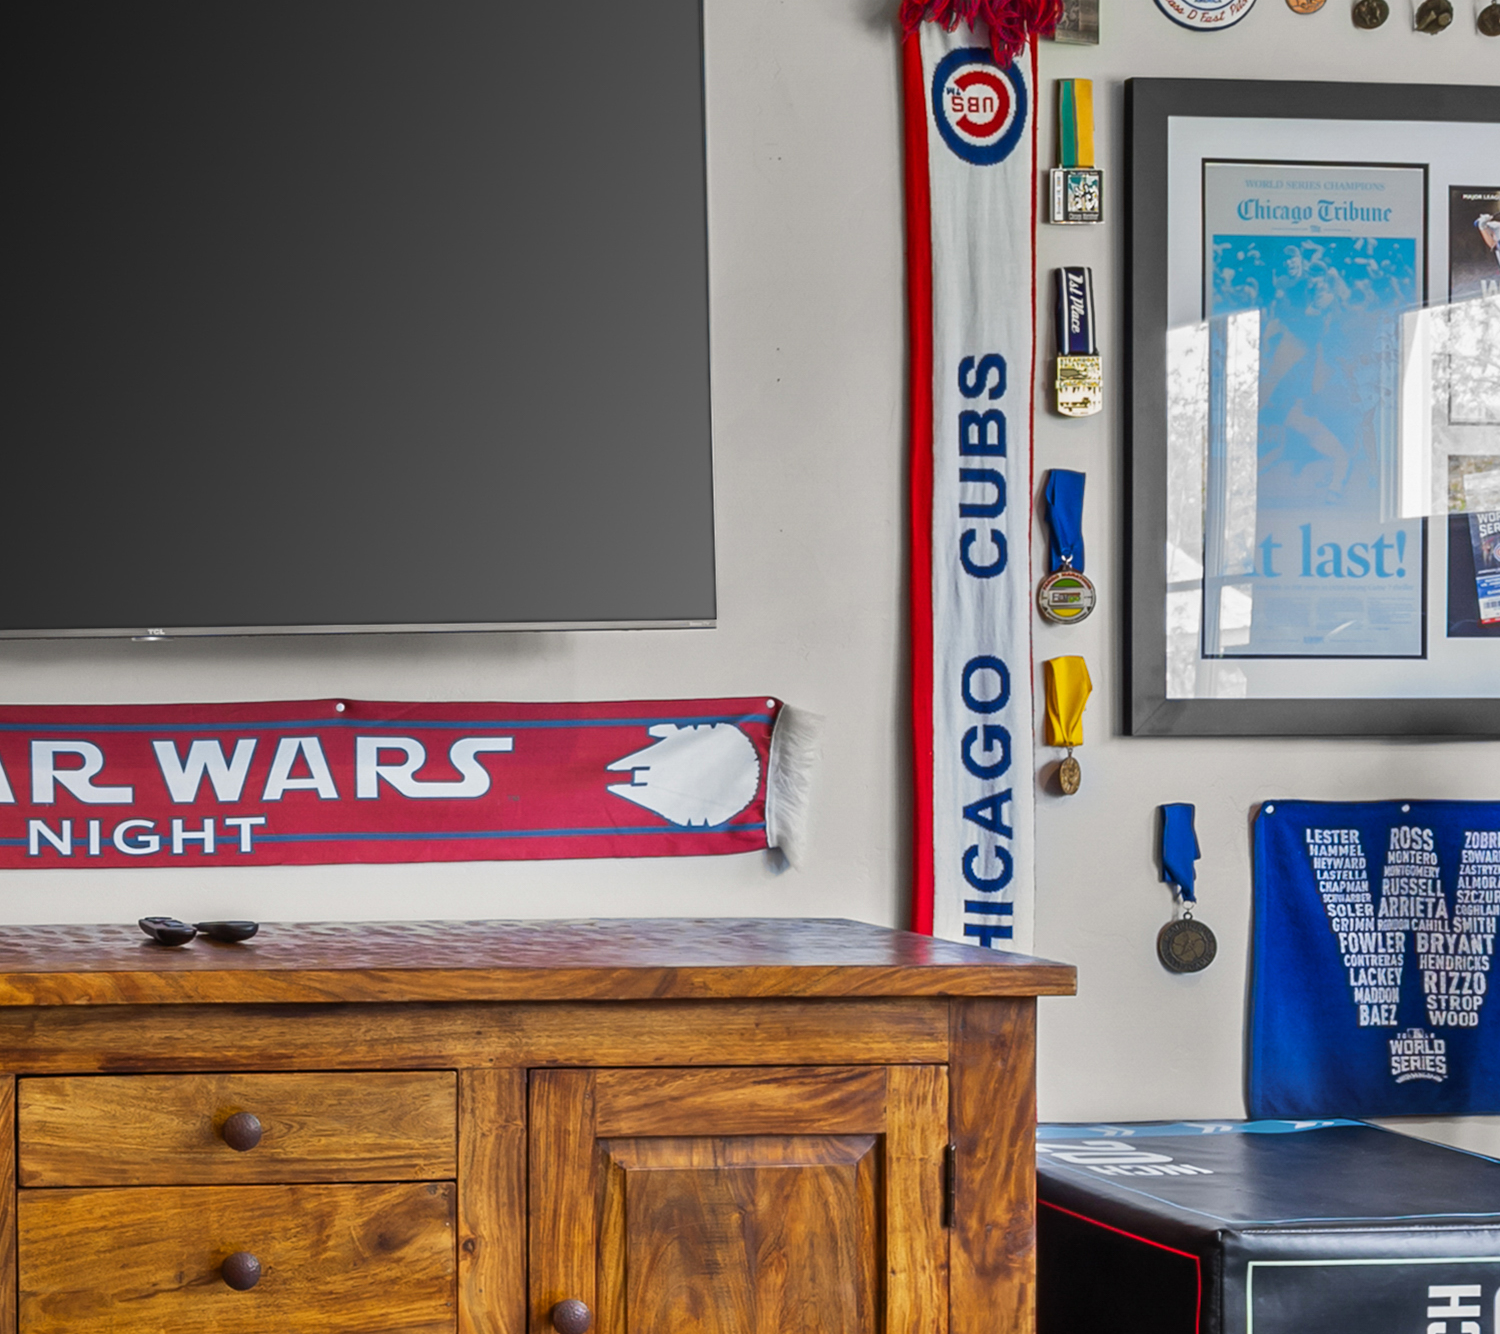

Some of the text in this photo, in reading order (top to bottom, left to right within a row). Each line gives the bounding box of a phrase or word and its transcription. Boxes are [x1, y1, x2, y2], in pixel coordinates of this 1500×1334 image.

[1187, 9, 1198, 20] D
[1245, 180, 1386, 191] WORLD SERIES CHAMPIONS
[1237, 198, 1393, 225] Chicago Tribune
[1070, 295, 1085, 334] Place
[958, 353, 1008, 579] CUBS
[1298, 522, 1407, 579] last!
[150, 735, 514, 805] WARS
[961, 654, 1013, 948] HICAGO
[24, 814, 267, 857] NIGHT
[1306, 829, 1360, 844] LESTER
[1390, 825, 1434, 851] ROSS
[1309, 845, 1365, 856] HAMMEL
[1387, 851, 1438, 865] MONTERO
[1313, 857, 1366, 869] HEYWARD
[1319, 881, 1369, 893] CHAPMAN
[1382, 878, 1445, 897] RUSSELL
[1327, 904, 1374, 917] SOLER
[1378, 897, 1448, 918] ARRIETA
[1455, 905, 1500, 916] COGHLAN
[1412, 919, 1451, 933] CAHILL
[1453, 917, 1497, 934] SMITH
[1338, 932, 1406, 953] FOWLER
[1416, 932, 1495, 954] BRYANT
[1344, 954, 1404, 967] CONTRERAS
[1419, 955, 1490, 971] HENDRICKS
[1350, 967, 1403, 986] LACKEY
[1424, 970, 1487, 995] RIZZO
[1354, 987, 1400, 1004] MADDON
[1426, 995, 1483, 1011] STROP
[1359, 1005, 1398, 1026] BAEZ
[1429, 1011, 1479, 1027] WOOD
[1389, 1039, 1445, 1055] WORLD
[1391, 1056, 1447, 1076] SERIES
